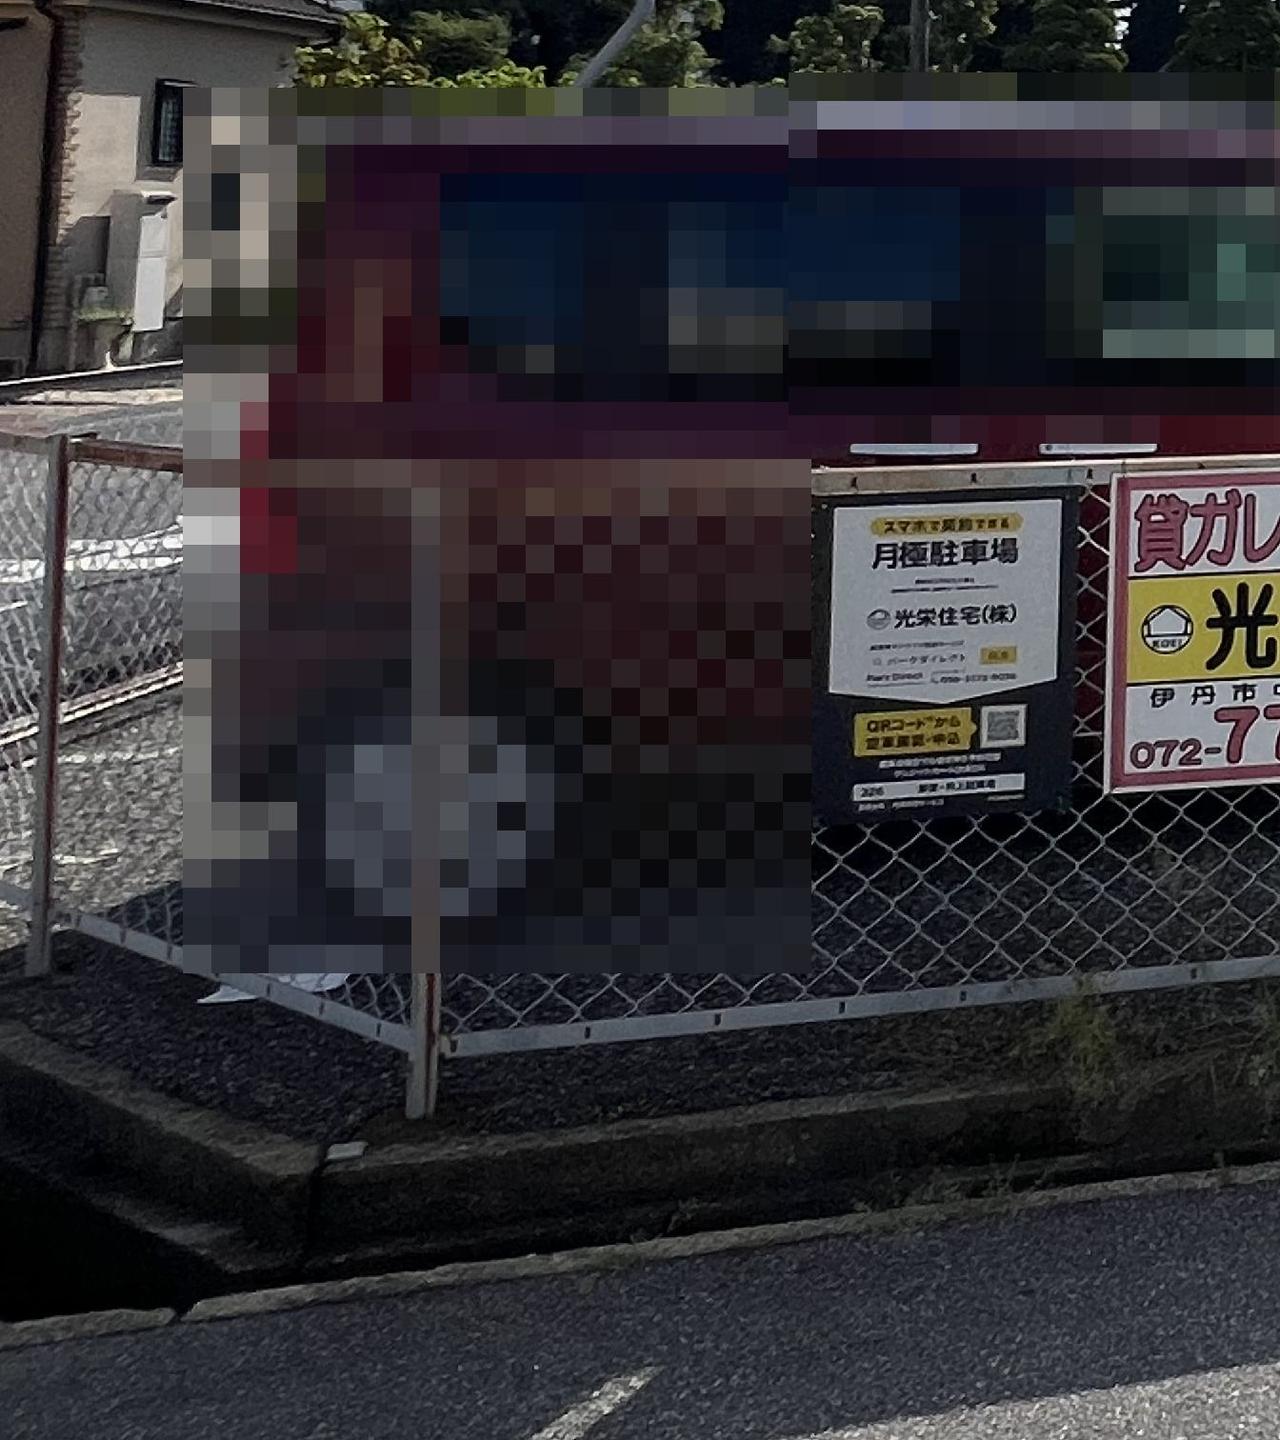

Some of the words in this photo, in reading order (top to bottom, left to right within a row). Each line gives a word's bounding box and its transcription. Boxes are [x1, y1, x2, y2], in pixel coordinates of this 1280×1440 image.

[872, 538, 1019, 569] 月極駐車場
[894, 603, 1017, 629] 光栄住宅(株)
